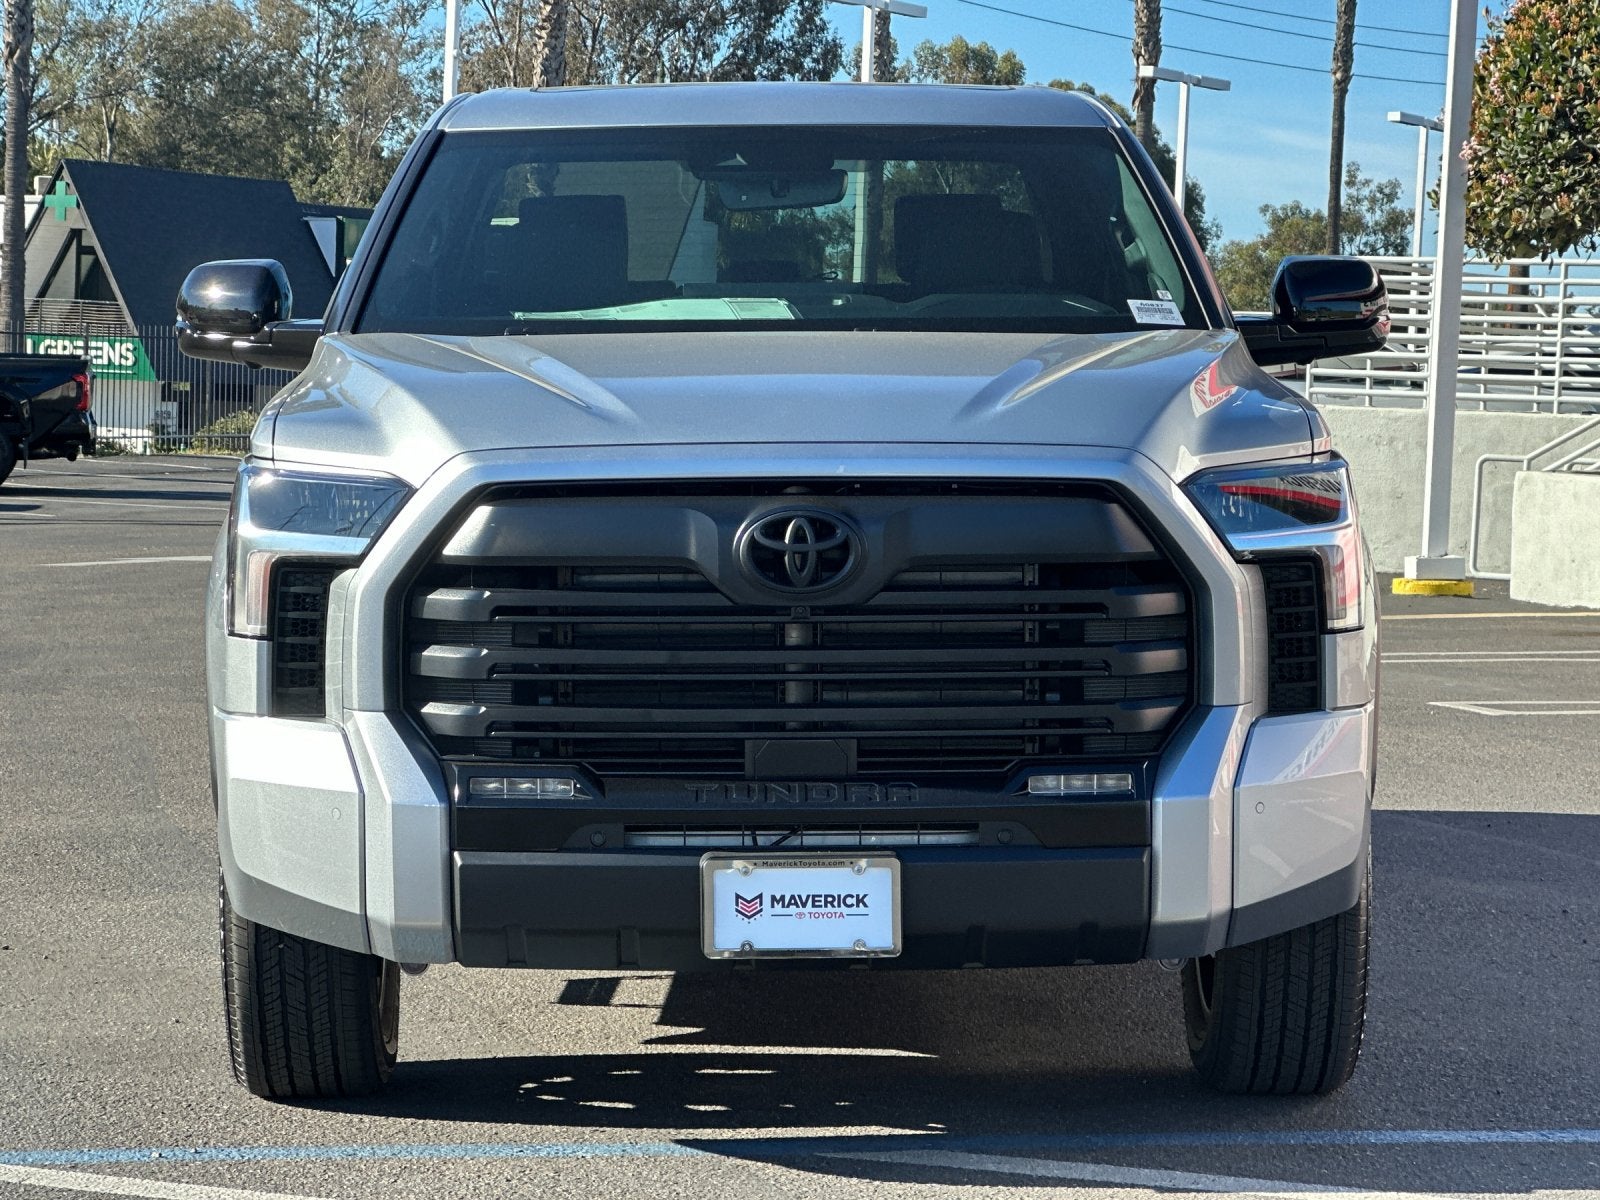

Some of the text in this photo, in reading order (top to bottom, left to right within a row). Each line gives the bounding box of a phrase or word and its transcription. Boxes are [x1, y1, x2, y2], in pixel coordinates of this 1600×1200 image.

[685, 783, 919, 802] TUNDRA
[770, 893, 869, 908] MAVERICK
[808, 911, 845, 919] TOYOTA
